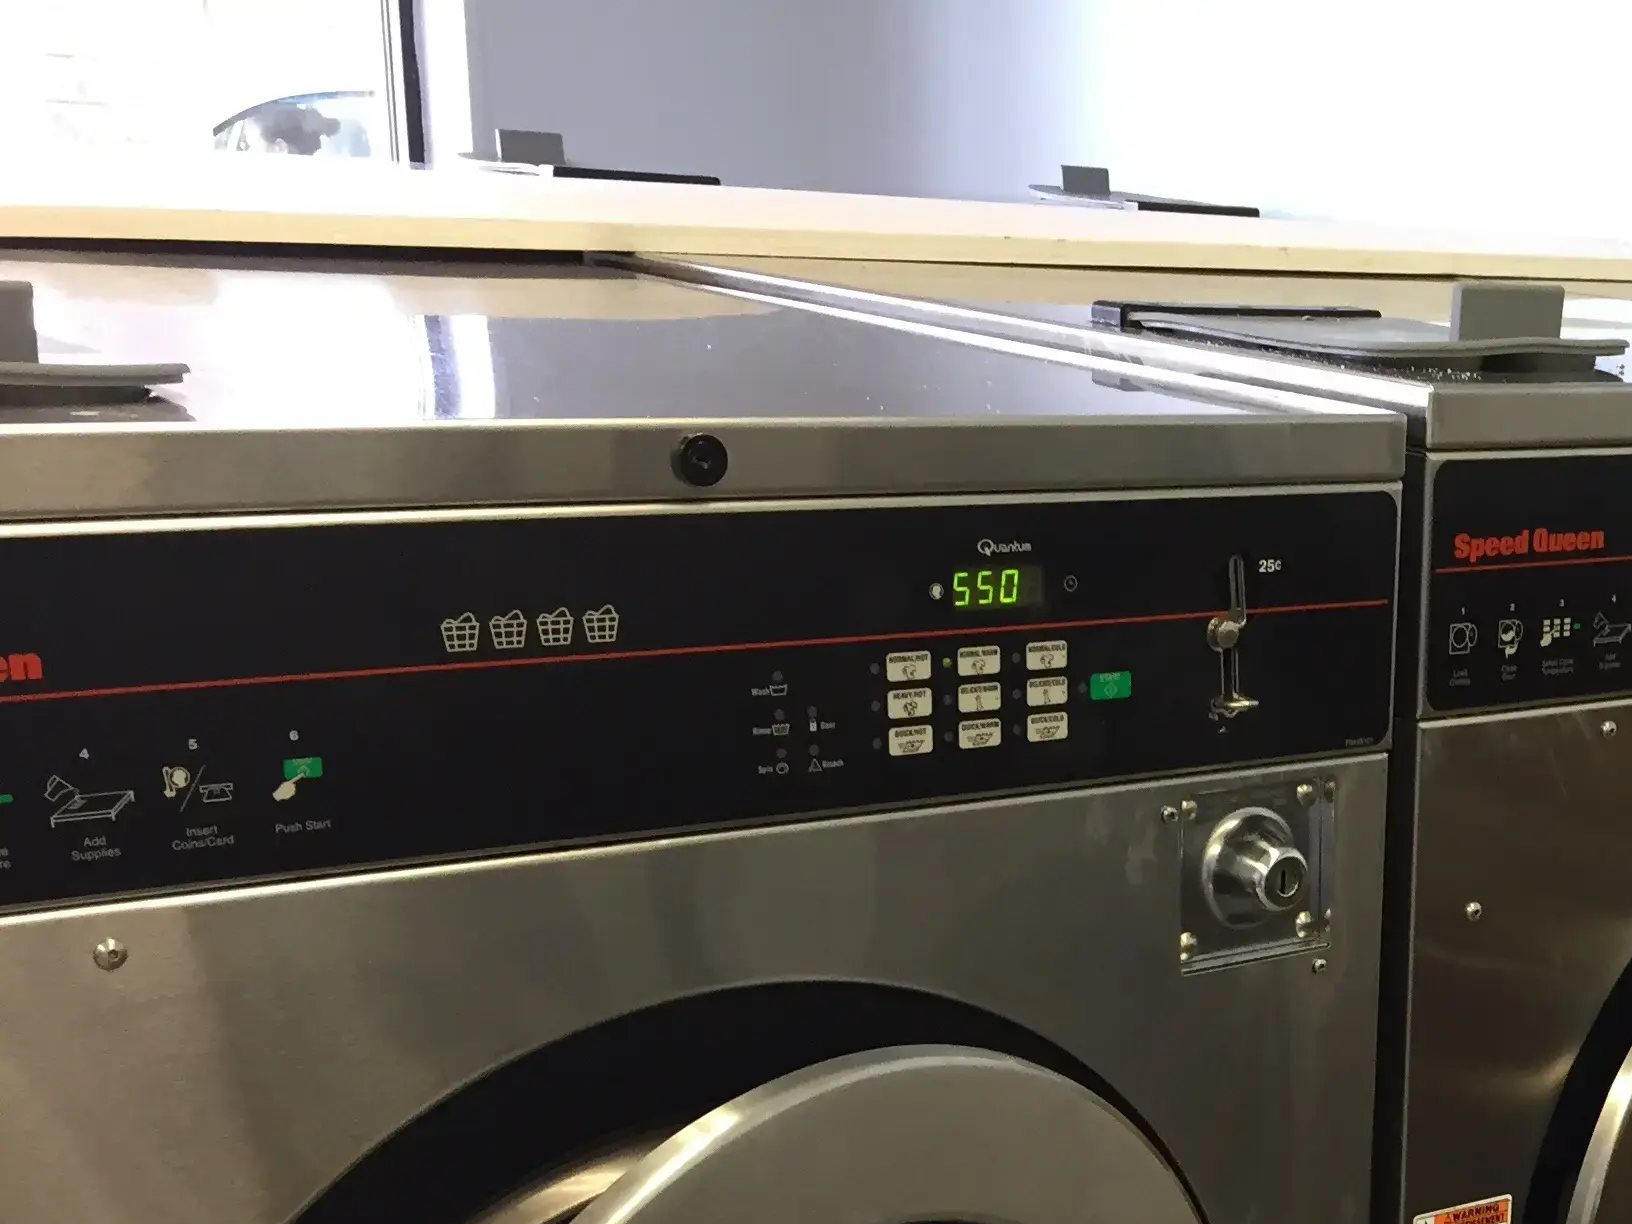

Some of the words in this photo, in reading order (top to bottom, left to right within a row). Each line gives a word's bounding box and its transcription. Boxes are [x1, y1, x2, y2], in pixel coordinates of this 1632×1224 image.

[977, 539, 1032, 556] Quantum
[1454, 528, 1530, 562] Speed
[1533, 527, 1605, 552] Queen
[953, 569, 1019, 606] 550
[289, 730, 299, 741] 6
[188, 738, 198, 750] 5
[79, 748, 90, 759] 4
[186, 825, 218, 837] Insert
[275, 822, 302, 834] Push
[305, 819, 332, 831] Start
[84, 835, 107, 847] Add
[172, 834, 234, 851] Coins/Card
[71, 846, 121, 861] Supplies
[1453, 1204, 1499, 1221] WARNING
